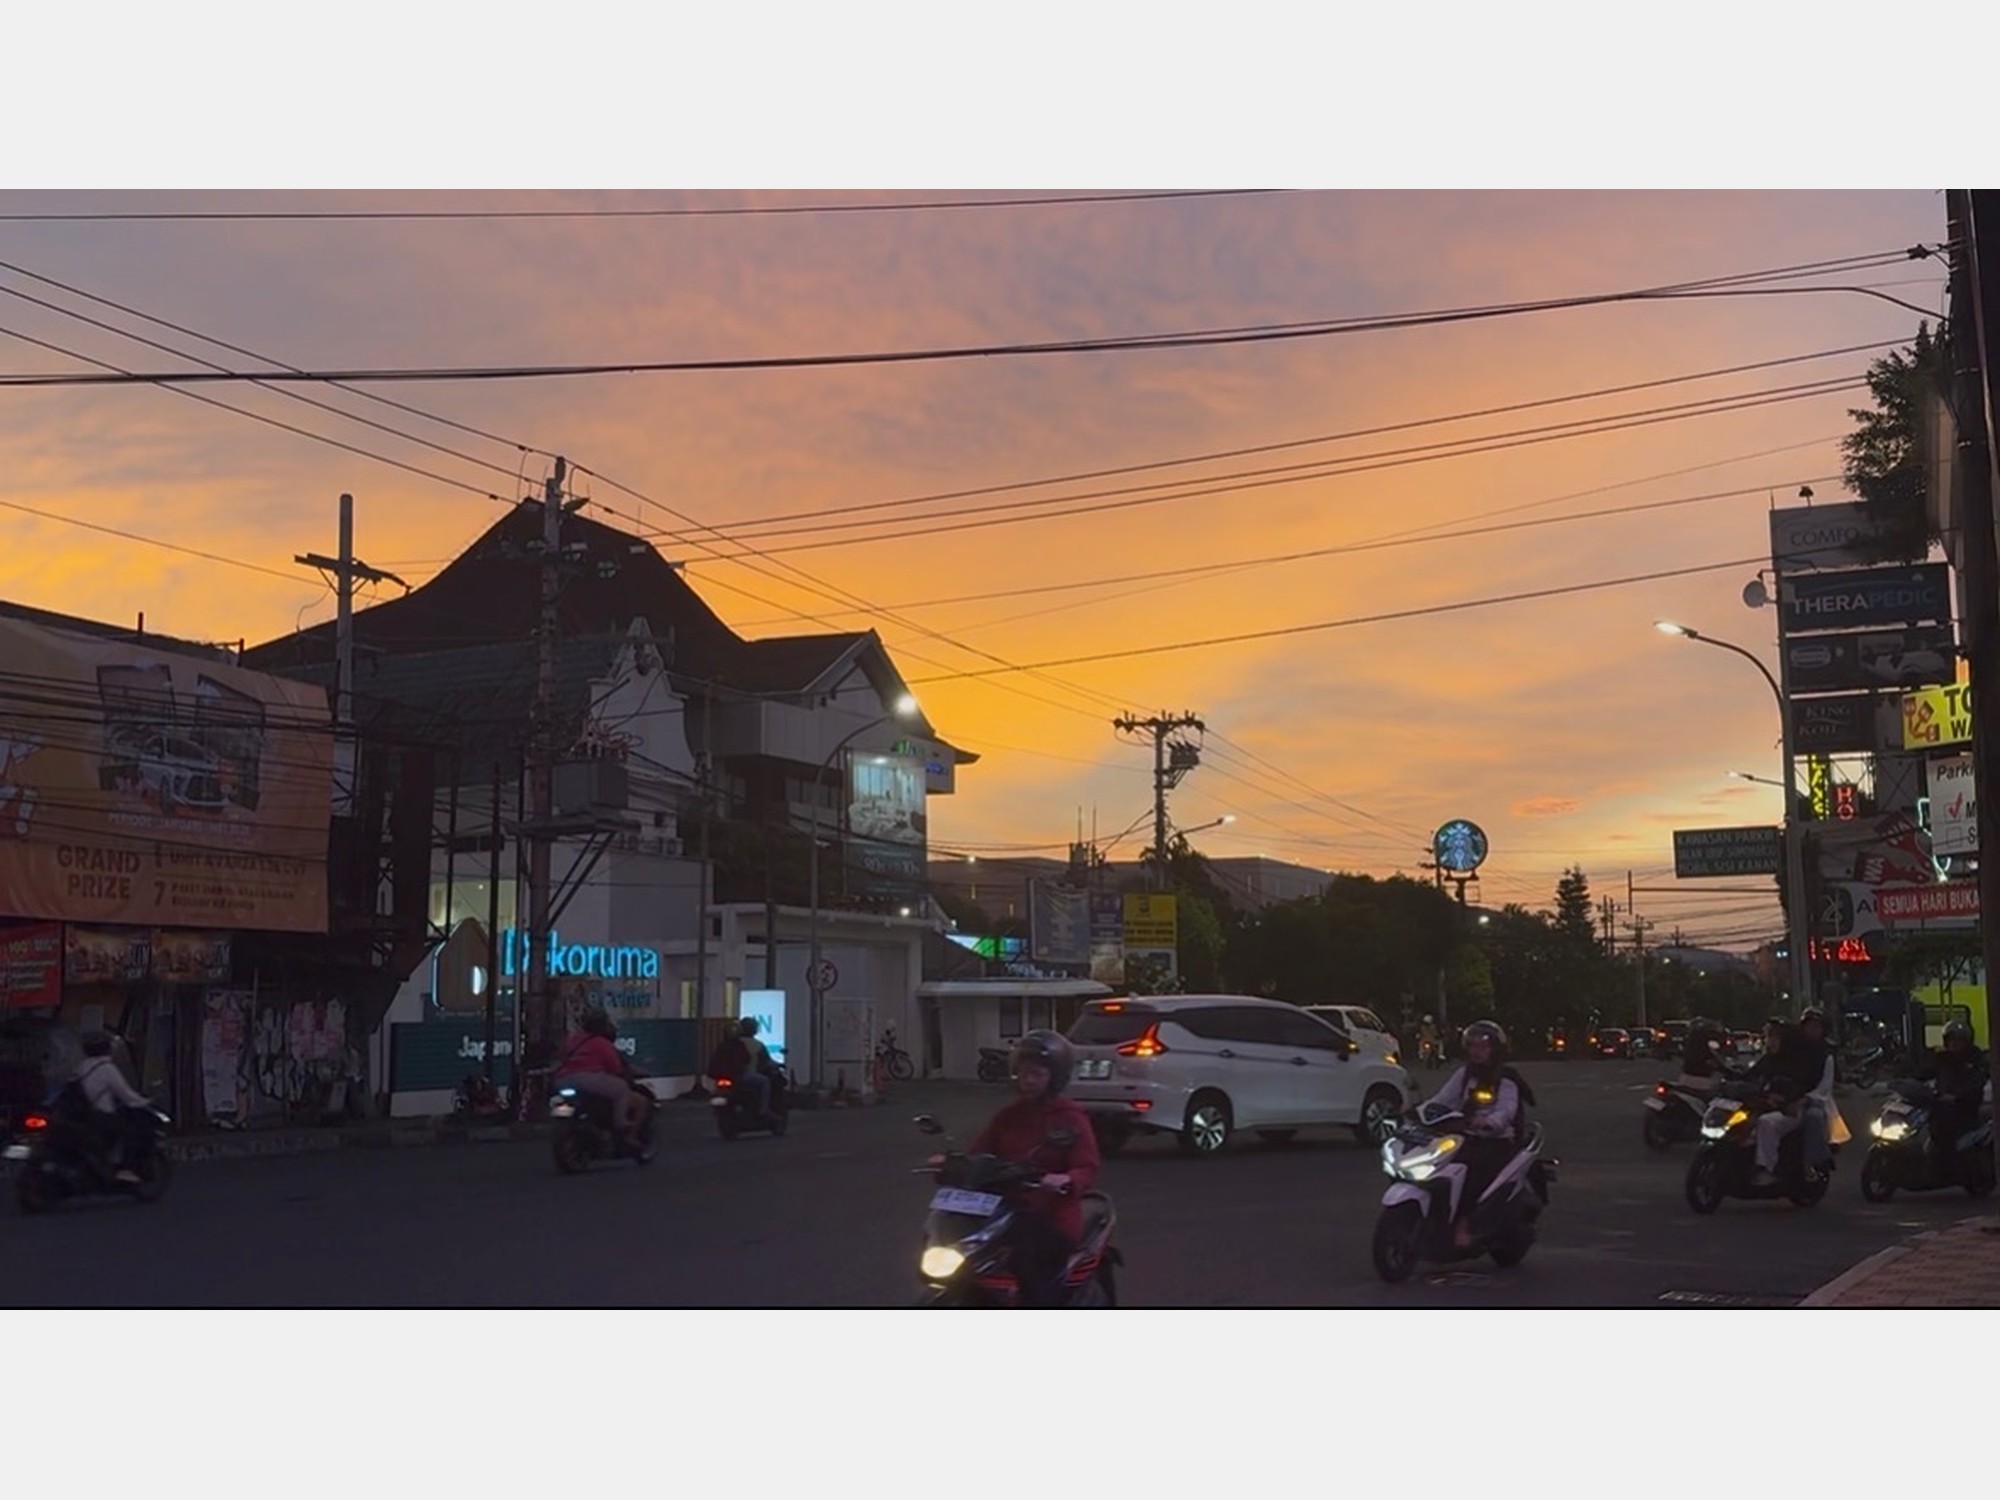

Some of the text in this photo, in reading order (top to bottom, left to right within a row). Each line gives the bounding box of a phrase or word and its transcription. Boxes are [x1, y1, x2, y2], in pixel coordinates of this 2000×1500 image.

[1793, 586, 1936, 615] THERAPEDIC
[57, 844, 140, 874] GRAND
[67, 871, 131, 902] PRIZE
[1882, 889, 1979, 915] SEMUA HARI BUKA
[502, 928, 660, 978] Dkoruma
